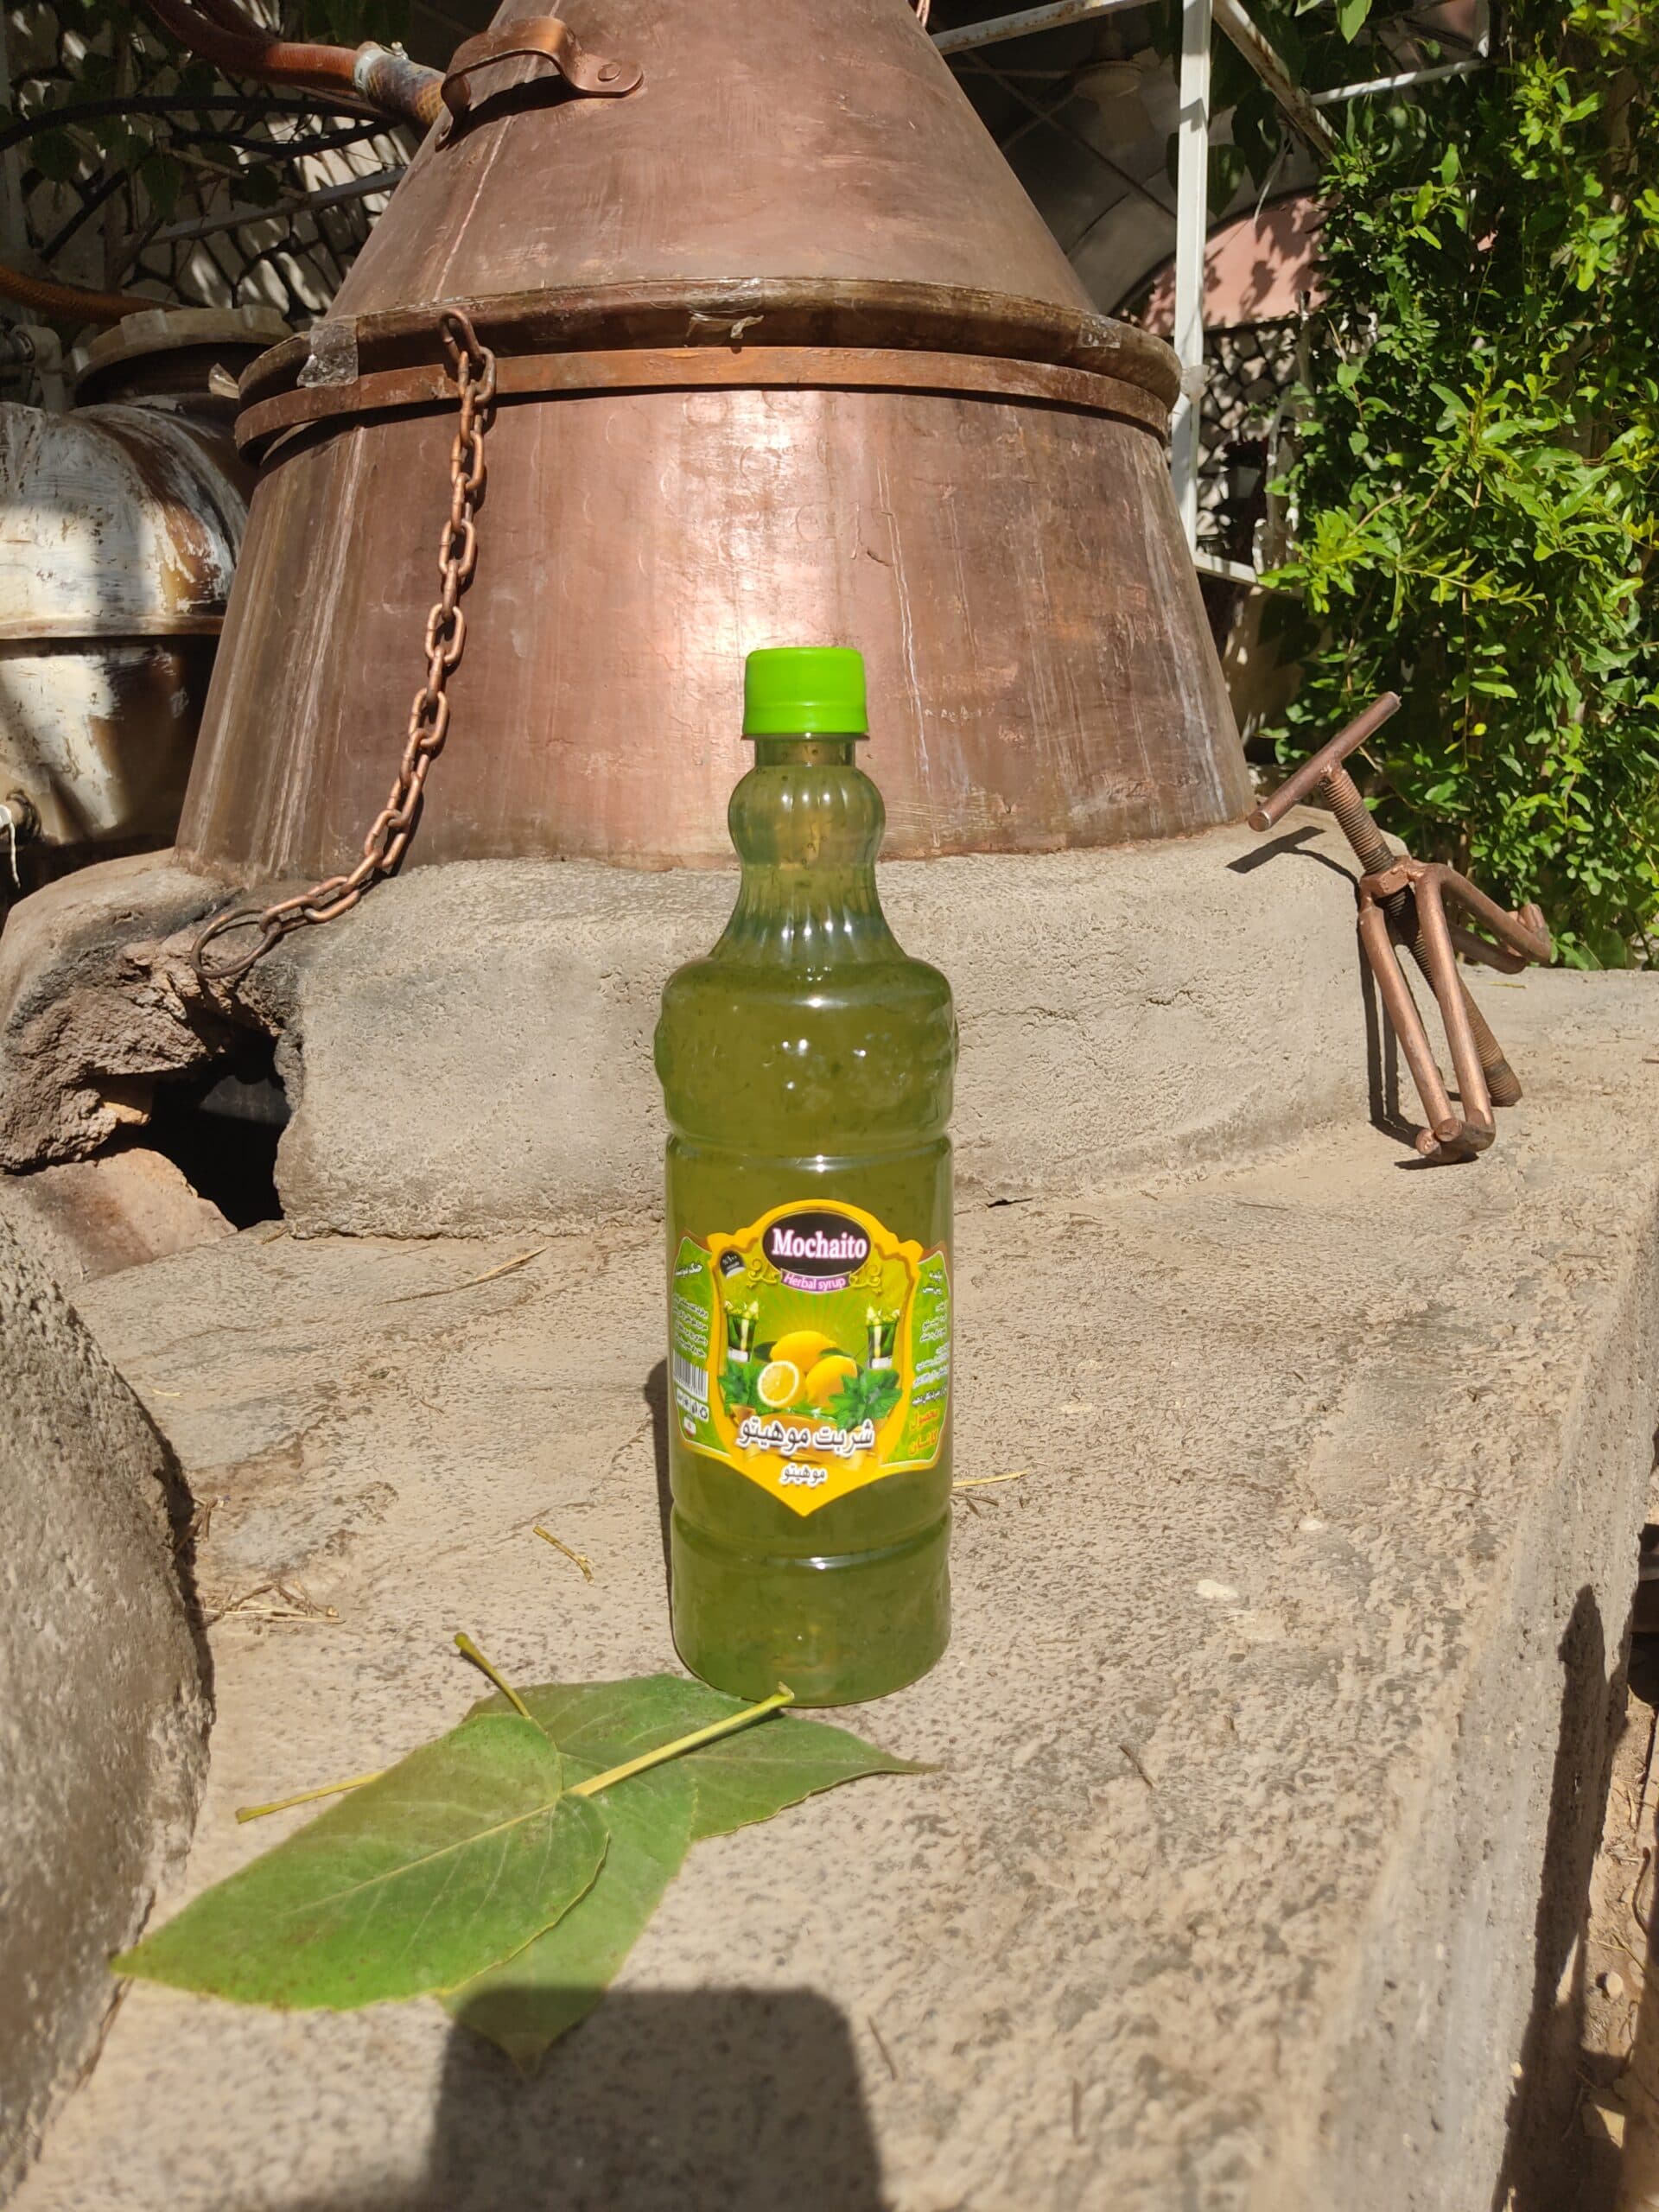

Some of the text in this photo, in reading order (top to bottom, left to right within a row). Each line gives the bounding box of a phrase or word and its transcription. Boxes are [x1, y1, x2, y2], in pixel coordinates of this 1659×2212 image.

[772, 1228, 868, 1259] Mochaito
[784, 1273, 846, 1291] Herbal syrup
[738, 1420, 874, 1454] شربت موهیتو
[781, 1465, 826, 1484] موهیتو
